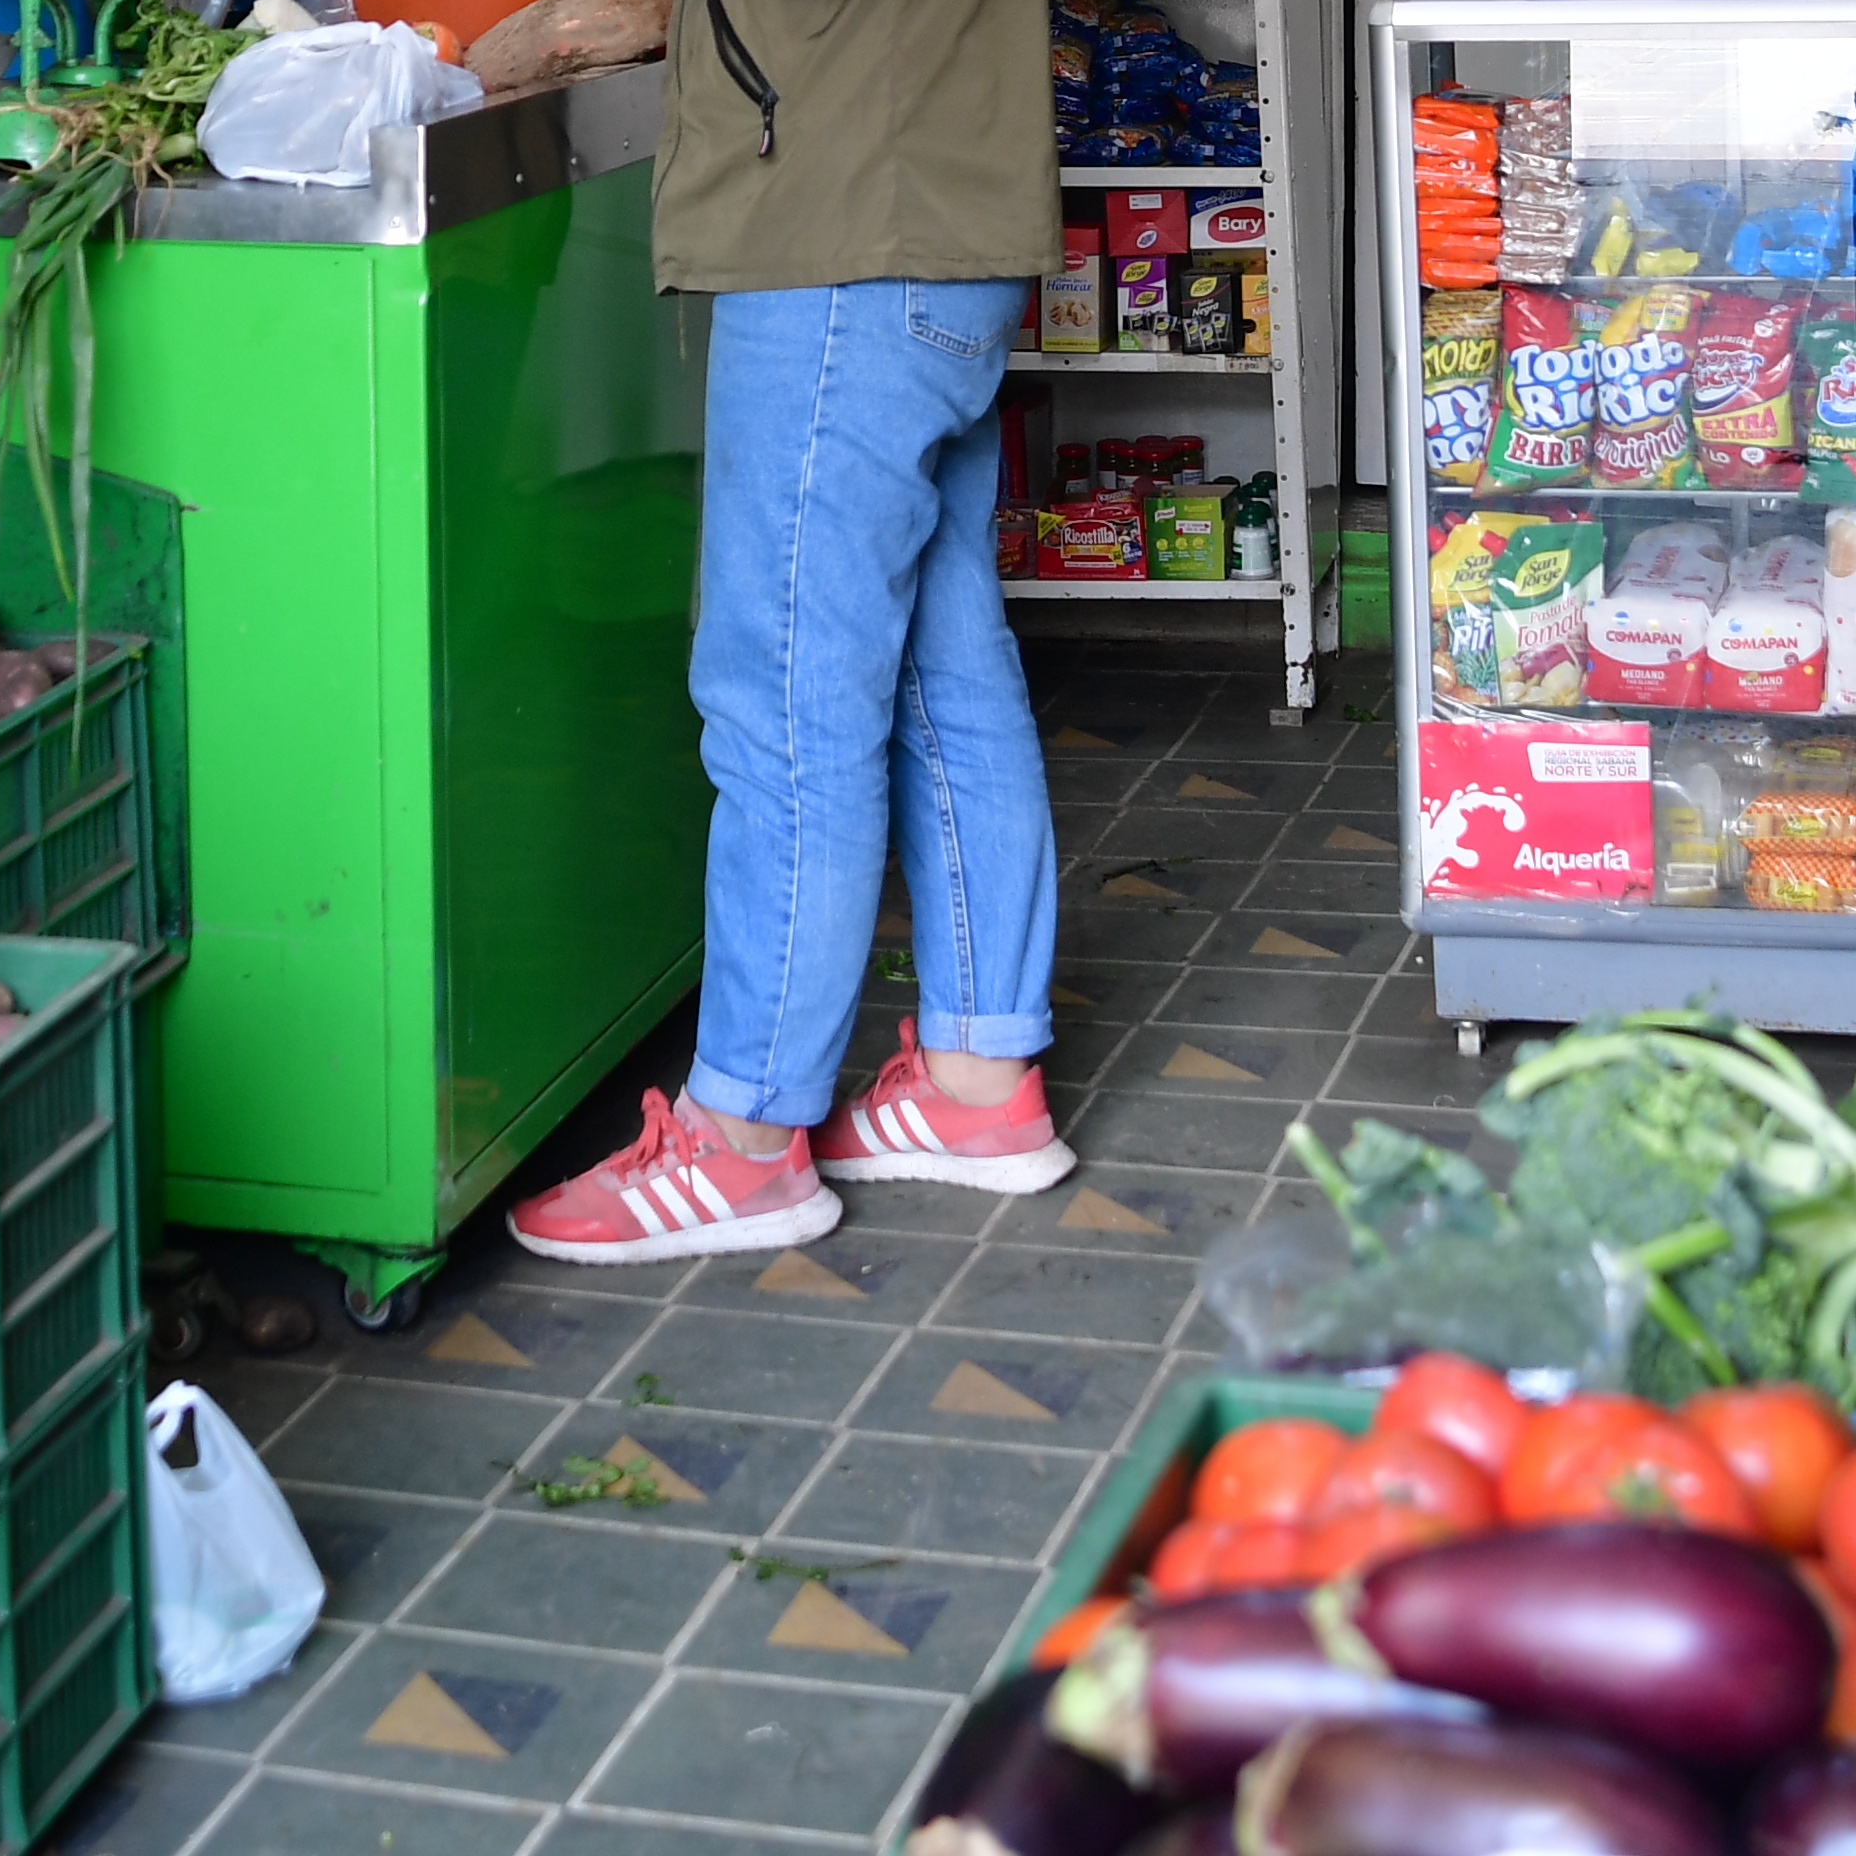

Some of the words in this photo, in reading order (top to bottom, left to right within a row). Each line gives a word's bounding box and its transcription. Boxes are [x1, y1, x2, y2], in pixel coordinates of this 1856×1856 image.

[1217, 216, 1263, 234] Bary
[1046, 279, 1093, 292] Hornear
[1697, 335, 1720, 346] APAS
[1510, 339, 1595, 386] Tod
[1701, 406, 1777, 432] EXTRA
[1701, 424, 1779, 441] CONTENIDO
[1508, 430, 1564, 466] BAR
[1064, 526, 1115, 545] Ricostilla
[1529, 554, 1558, 573] San
[1453, 566, 1491, 585] Jorg
[1521, 566, 1562, 592] Jorge
[1530, 603, 1564, 624] Pasta
[1564, 595, 1577, 613] de
[1605, 630, 1683, 646] COMAPAN
[1720, 636, 1799, 651] COMAPAN
[1621, 669, 1665, 681] MEDIANO
[1583, 748, 1636, 757] EXHIBICIÓN
[1544, 766, 1592, 777] NORTE
[1595, 766, 1605, 777] Y
[1608, 766, 1638, 777] SUR
[1513, 842, 1631, 878] Alquería
